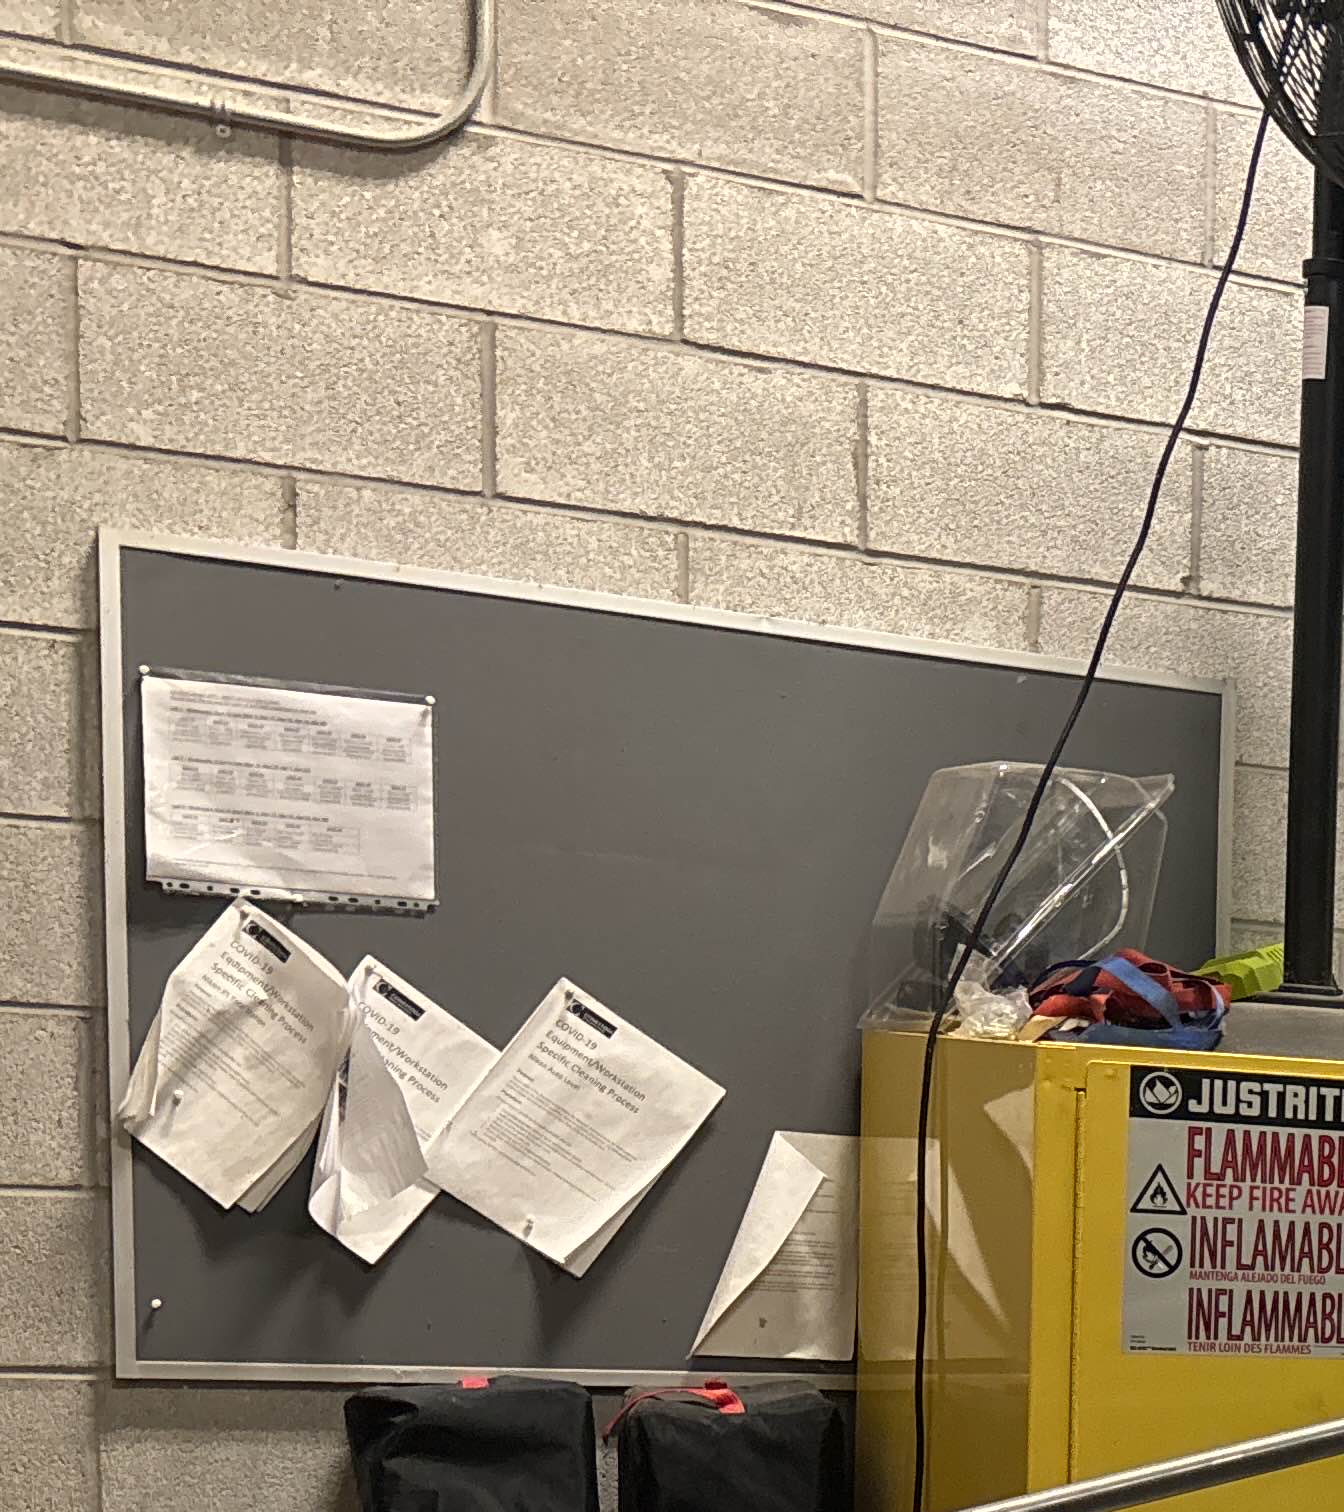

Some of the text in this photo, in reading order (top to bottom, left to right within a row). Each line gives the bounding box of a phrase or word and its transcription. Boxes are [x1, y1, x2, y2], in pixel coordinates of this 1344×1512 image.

[229, 939, 274, 975] COVID-19
[210, 962, 245, 993] Specific
[277, 1015, 308, 1045] Process
[220, 951, 315, 1032] Equipment/Workstation
[358, 1002, 401, 1036] COVID-19
[555, 1018, 598, 1051] COVID-19
[370, 1030, 448, 1090] ment/Workstation
[545, 1030, 646, 1102] Equipment/Workstation
[407, 1075, 441, 1103] Process
[536, 1041, 640, 1115] Specific Cleaning Process
[1186, 1182, 1243, 1211] KEEP
[1248, 1187, 1296, 1214] FIRE
[1189, 1270, 1326, 1286] MANTENGA ALEJADO DEL FUEGO
[1187, 1341, 1217, 1353] TENIR
[1218, 1342, 1242, 1353] LOIN
[1244, 1342, 1262, 1354] DES
[1263, 1343, 1312, 1355] FLAMMES
